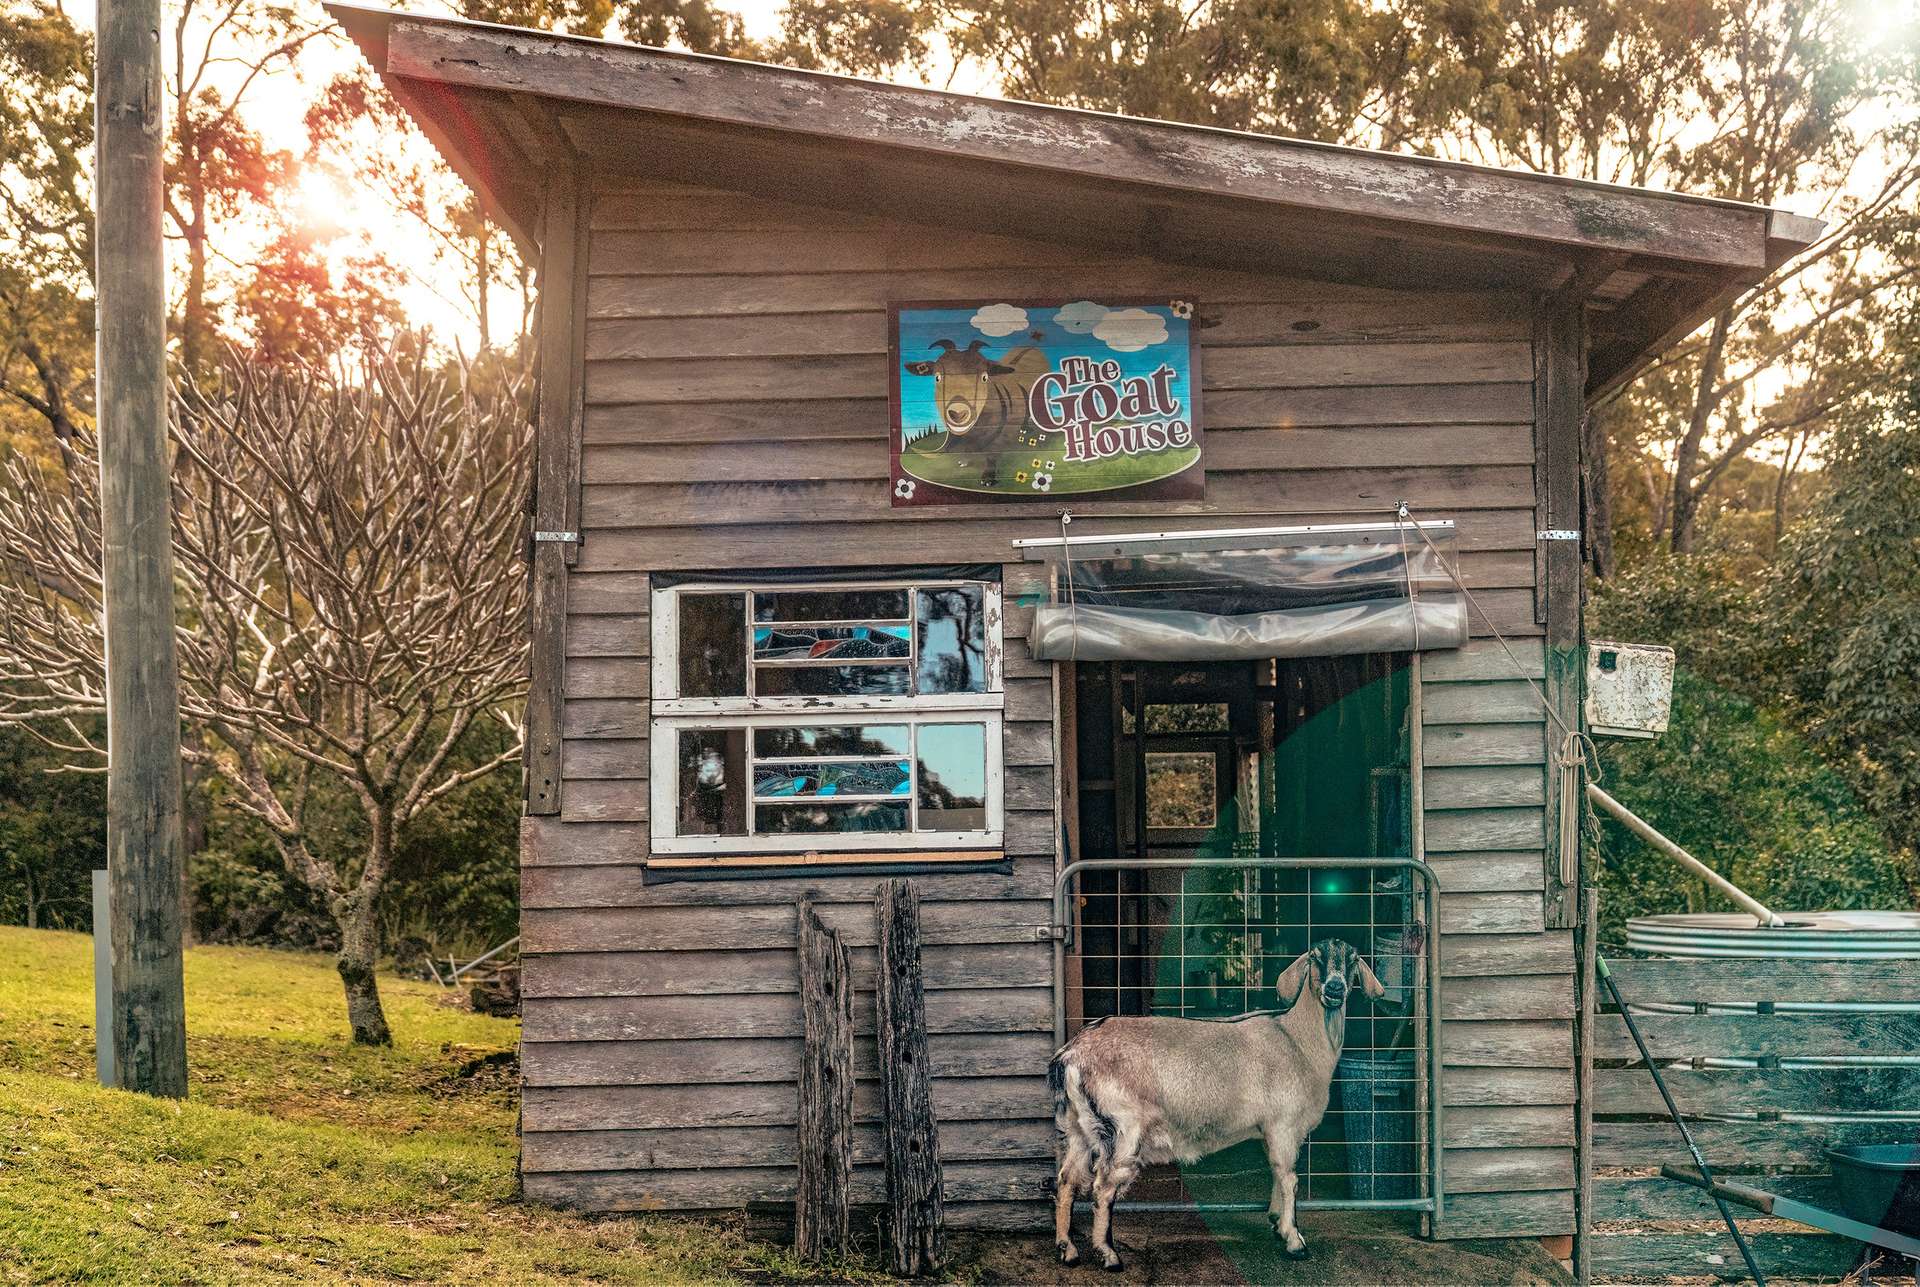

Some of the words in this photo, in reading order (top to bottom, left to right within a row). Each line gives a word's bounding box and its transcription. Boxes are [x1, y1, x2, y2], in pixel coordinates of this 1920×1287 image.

[1061, 357, 1120, 386] The
[1030, 364, 1179, 431] Goat
[1063, 419, 1191, 460] House
